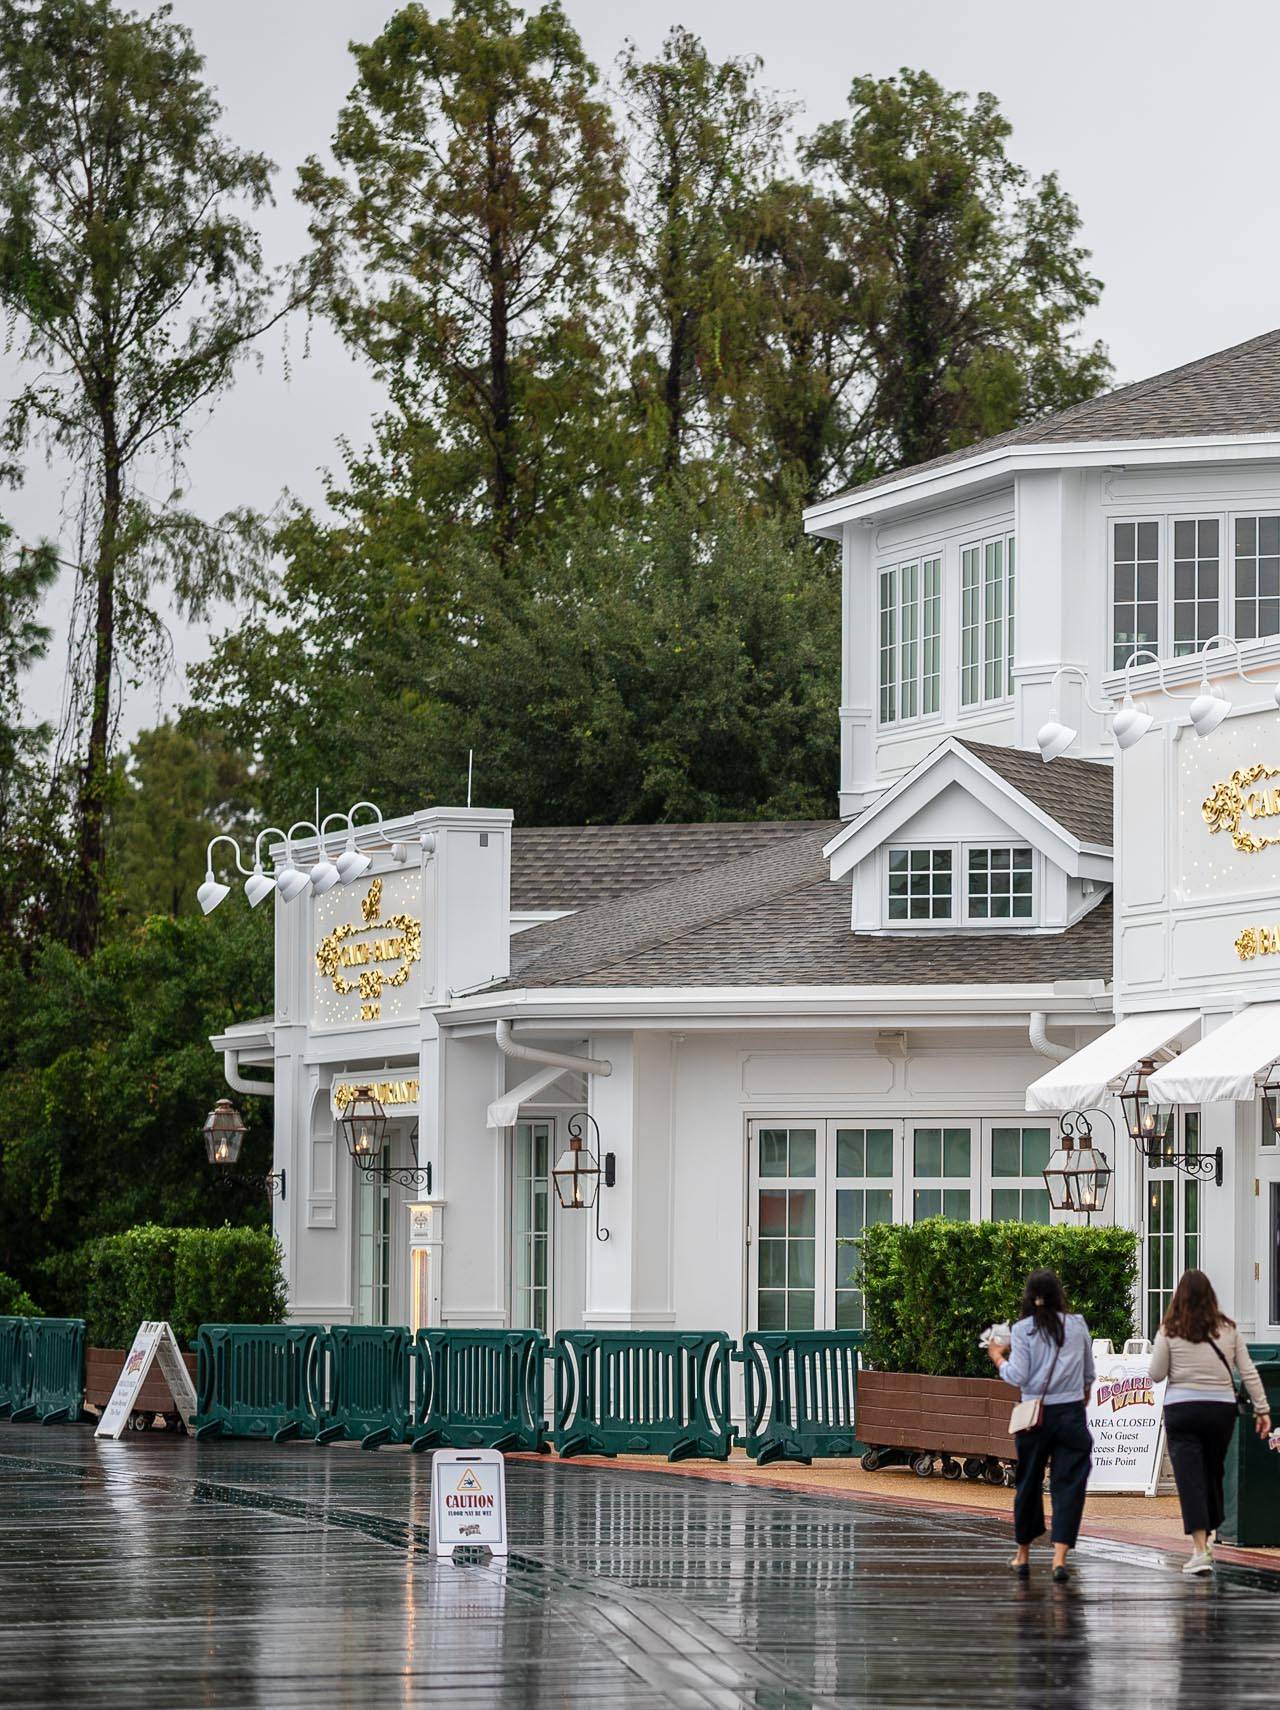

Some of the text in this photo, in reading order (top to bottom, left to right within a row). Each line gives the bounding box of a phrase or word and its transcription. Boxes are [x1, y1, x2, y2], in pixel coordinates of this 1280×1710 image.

[1097, 1376, 1153, 1406] BOARD
[1111, 1390, 1155, 1413] WALK
[1087, 1418, 1156, 1428] AREA CLOSED
[1100, 1431, 1139, 1441] No Guest
[1093, 1444, 1150, 1455] ccess Beyond
[1095, 1457, 1137, 1467] This Point
[446, 1494, 494, 1508] CAUTION
